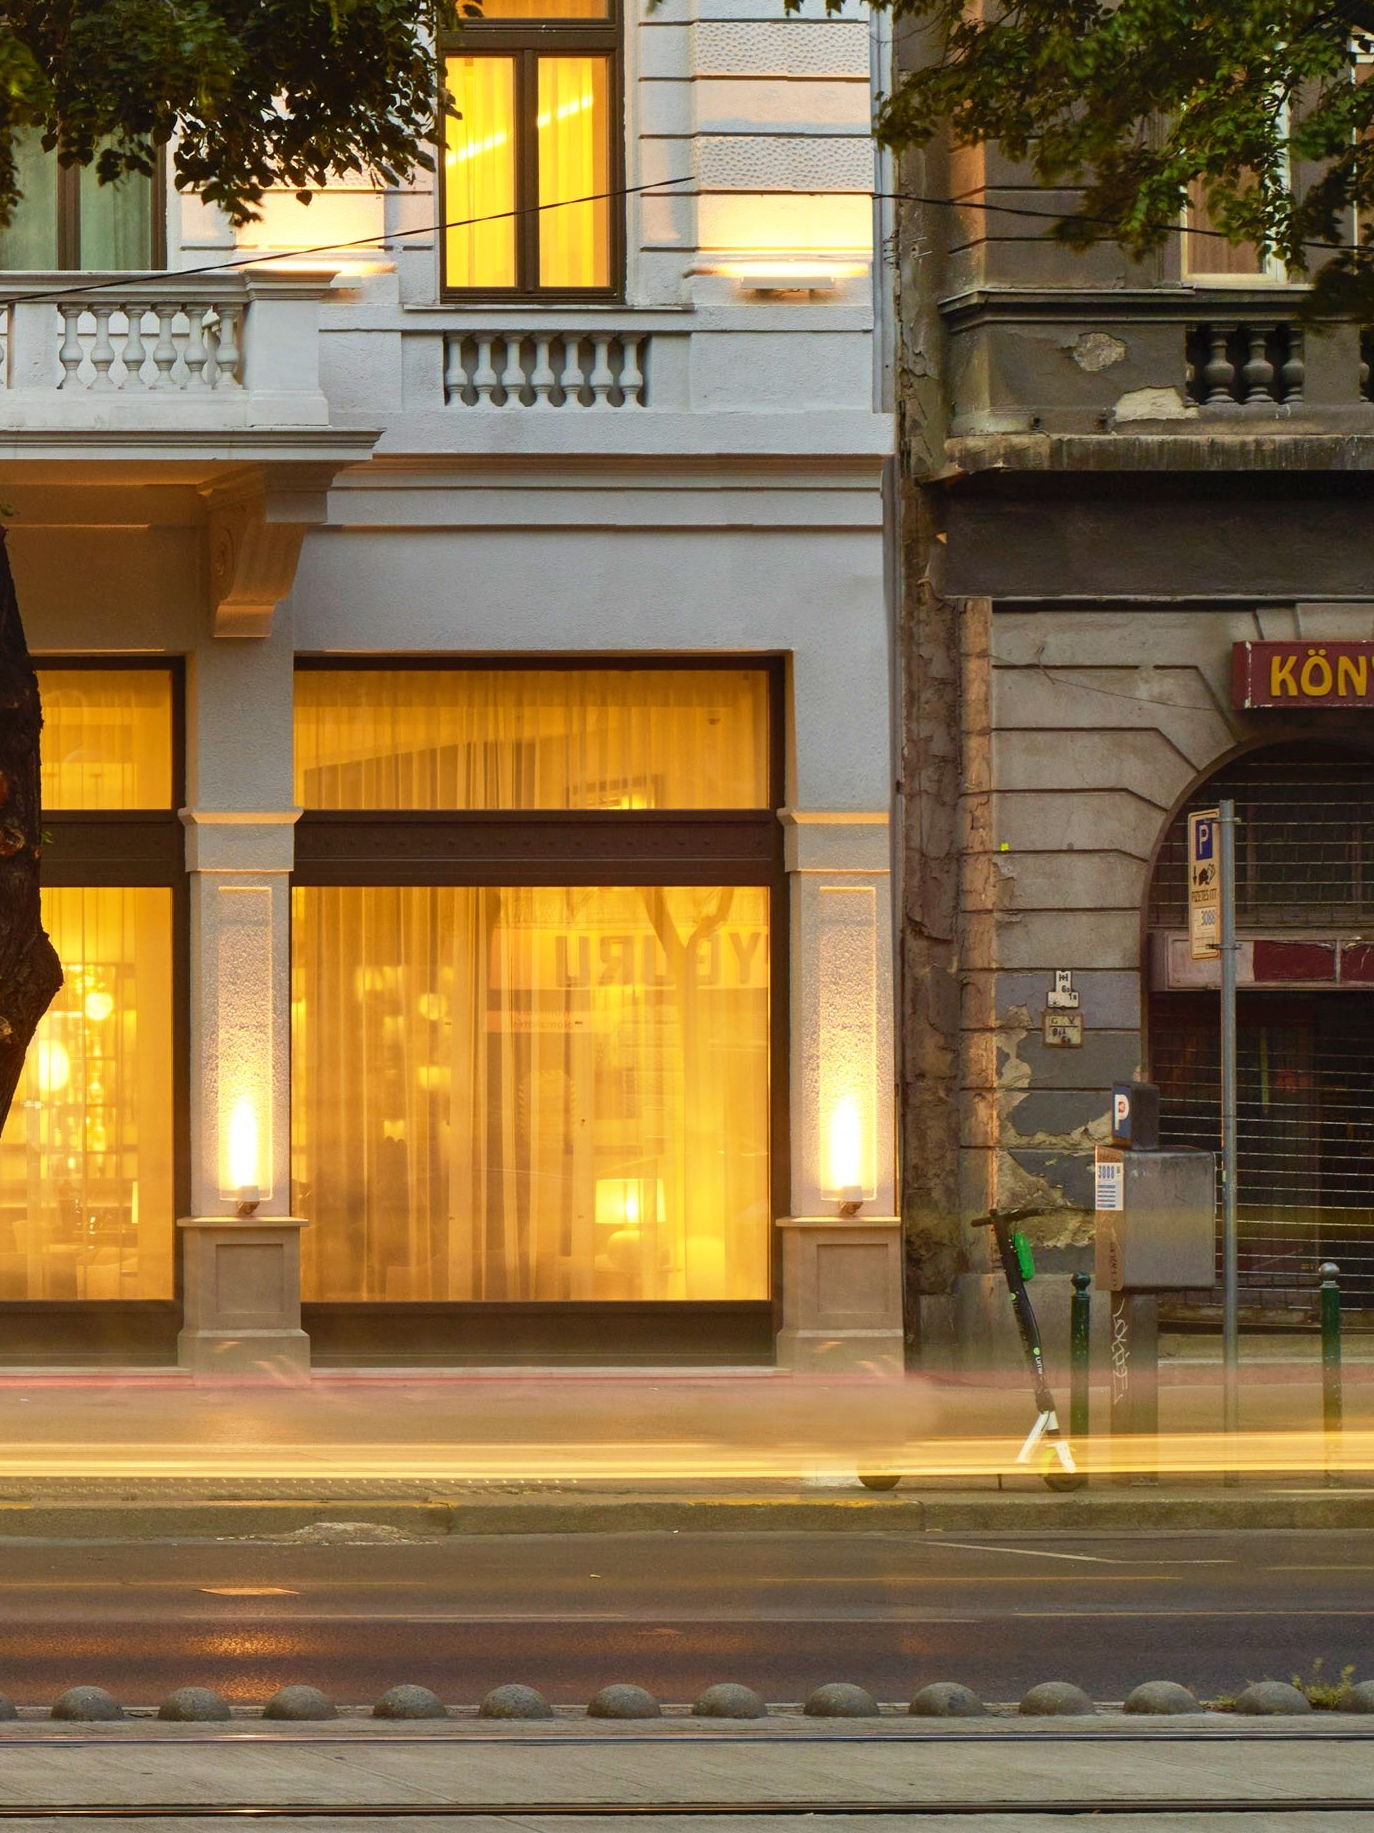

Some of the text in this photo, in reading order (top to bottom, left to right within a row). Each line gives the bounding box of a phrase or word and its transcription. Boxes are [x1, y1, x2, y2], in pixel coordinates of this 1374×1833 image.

[1270, 648, 1374, 697] KÖN
[1198, 824, 1209, 855] P
[1114, 1093, 1130, 1131] P
